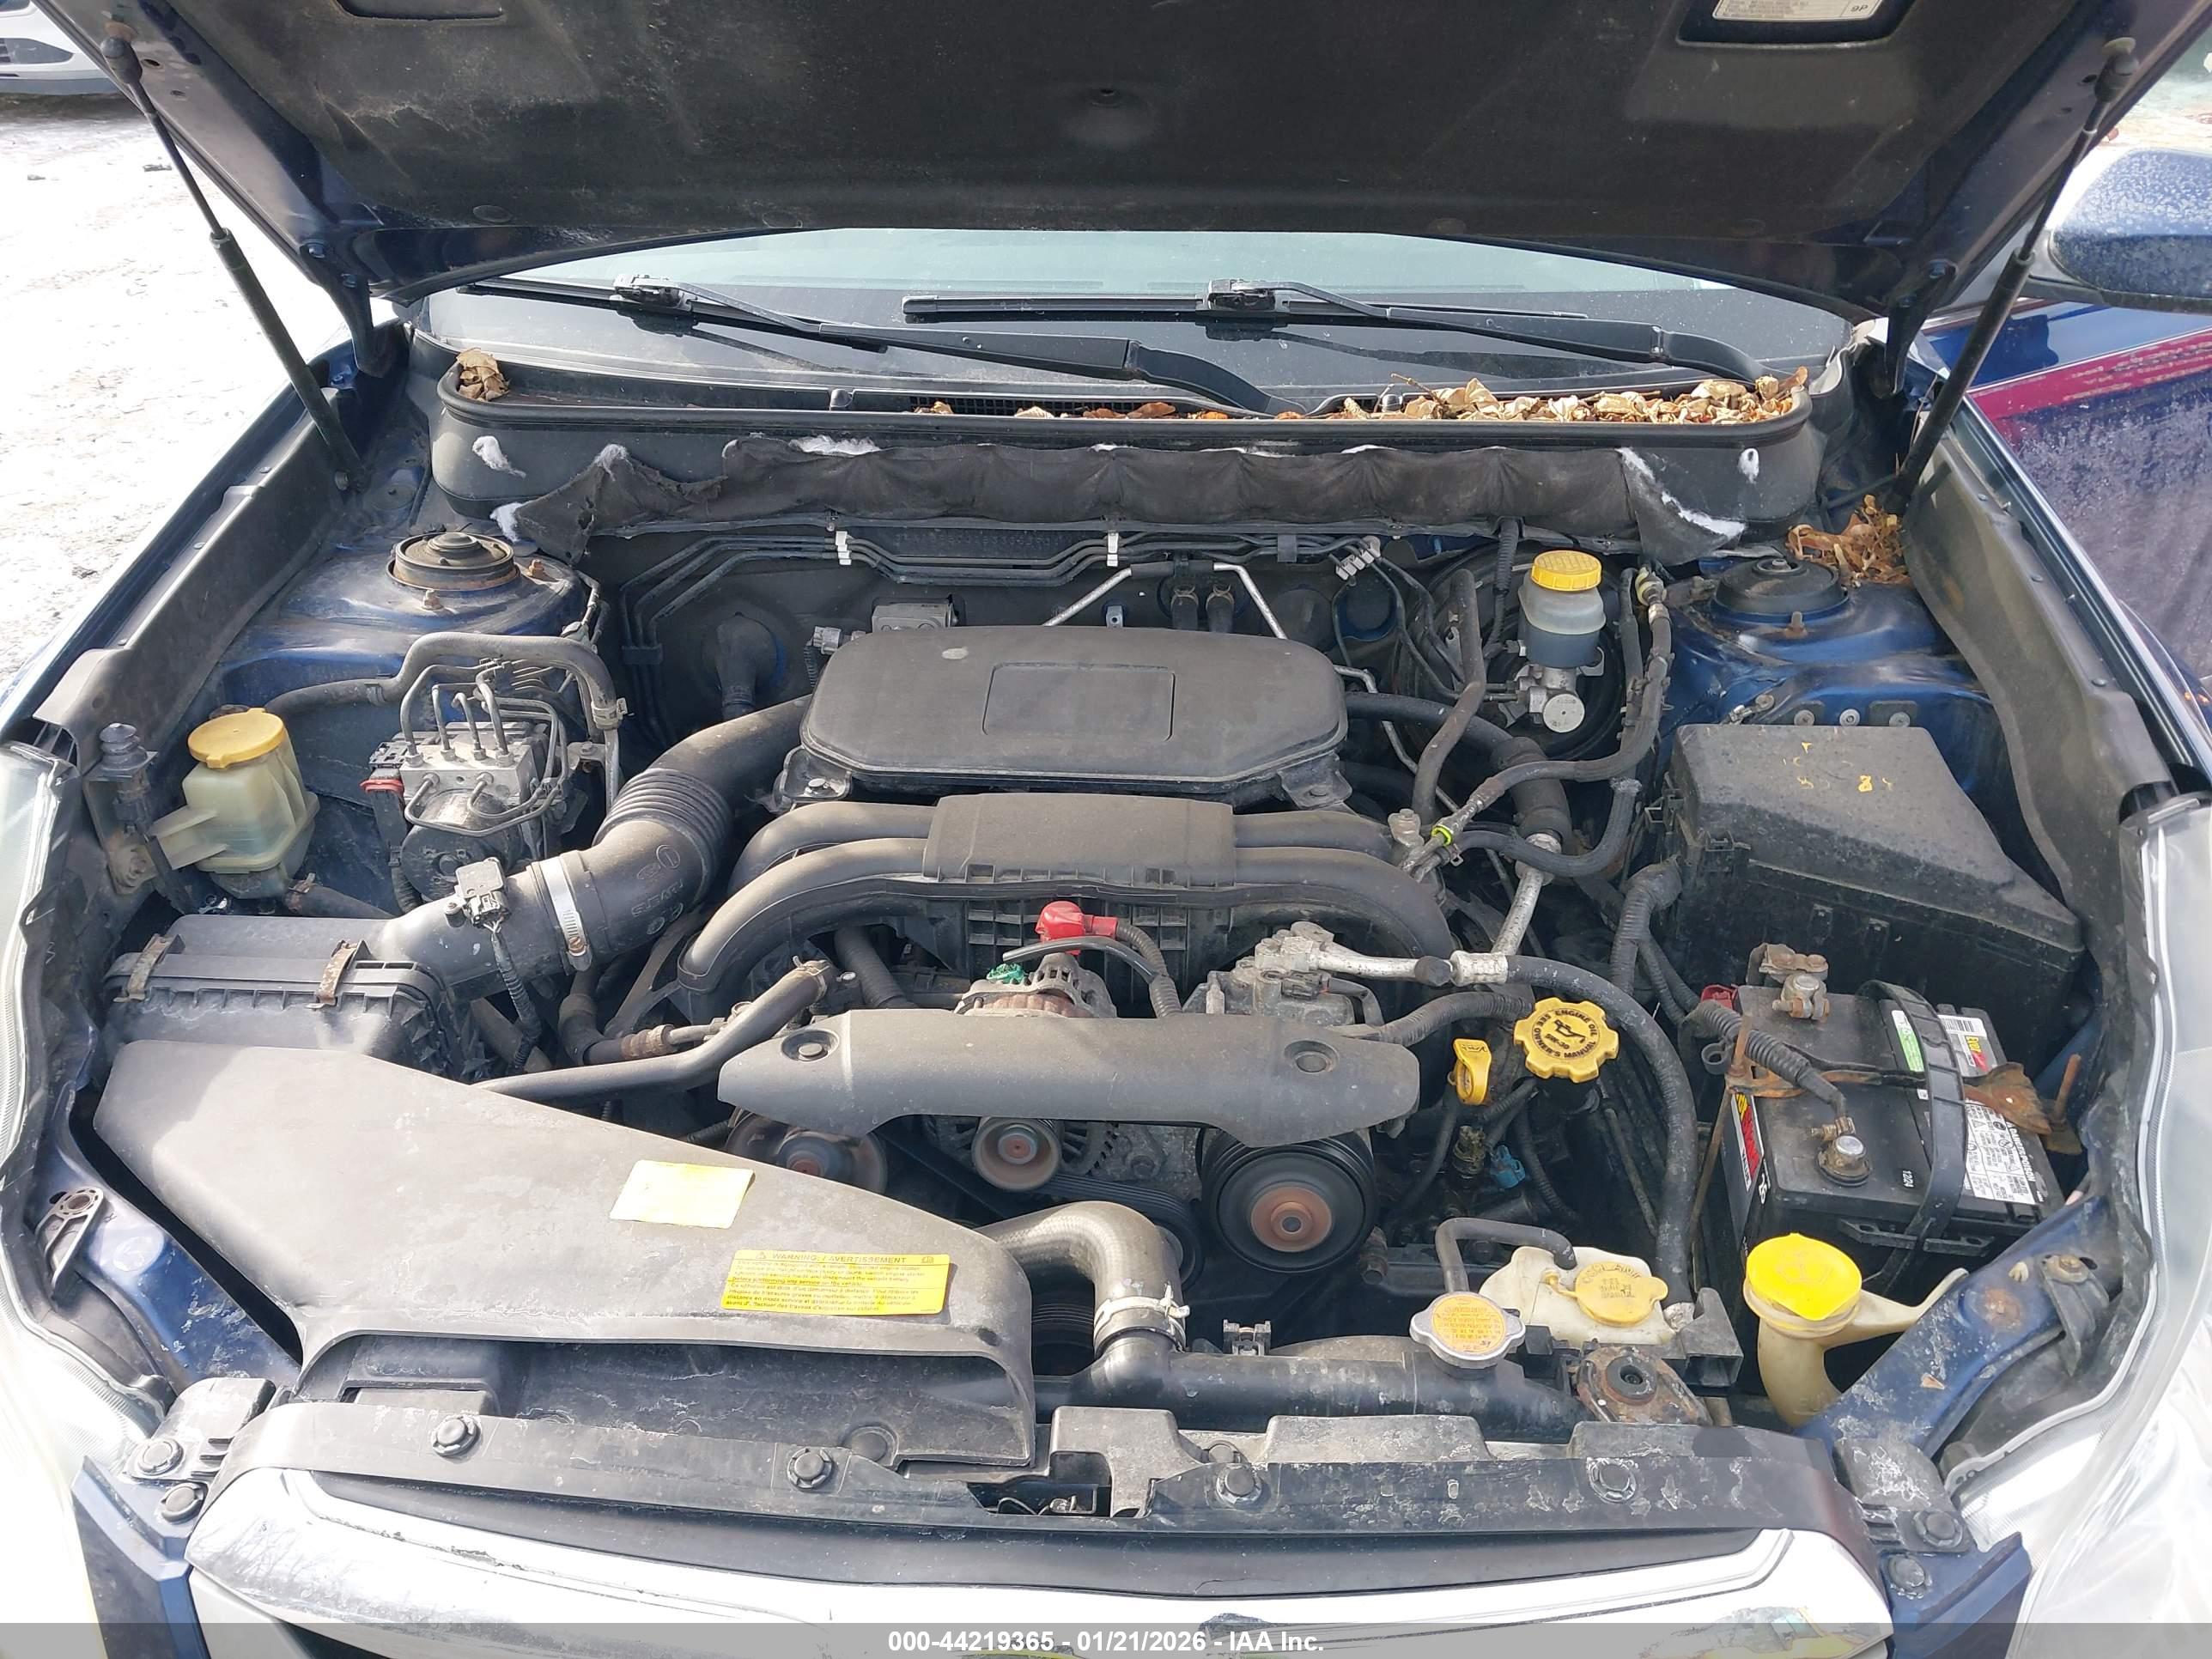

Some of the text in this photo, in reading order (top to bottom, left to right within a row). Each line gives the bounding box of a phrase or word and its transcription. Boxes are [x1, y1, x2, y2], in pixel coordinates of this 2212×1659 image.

[1534, 1013, 1597, 1059] SEE OWNER'S MANUAL
[1554, 1008, 1598, 1037] ENGINE OIL
[1544, 1033, 1571, 1050] 5W-30
